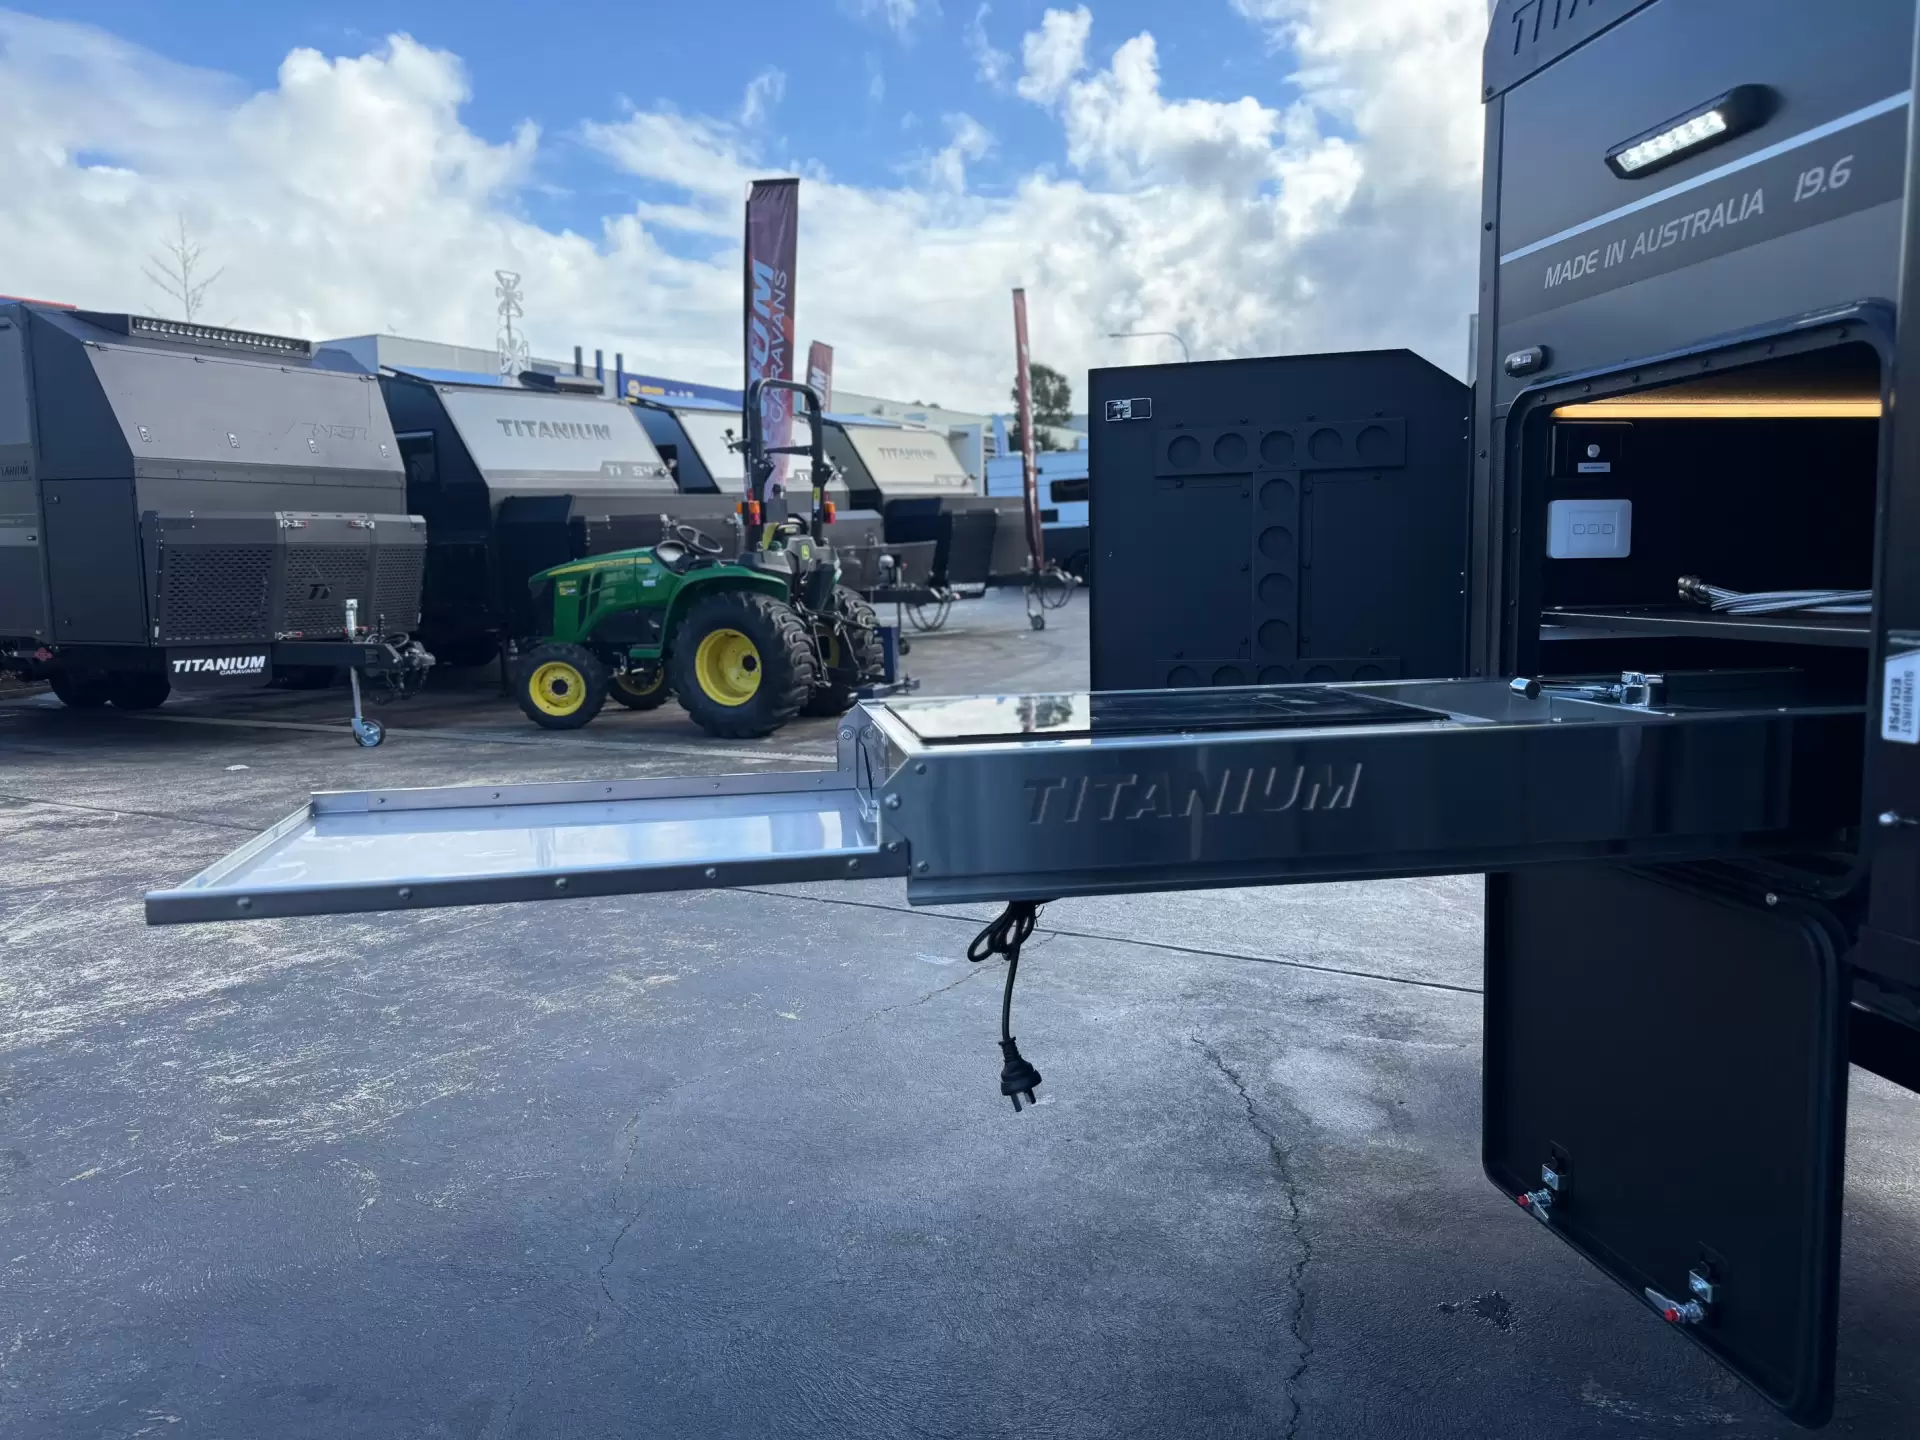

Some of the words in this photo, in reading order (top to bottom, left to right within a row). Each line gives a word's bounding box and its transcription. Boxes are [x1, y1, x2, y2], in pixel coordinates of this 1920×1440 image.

[1544, 249, 1600, 290] MADE
[1604, 239, 1626, 268] IN
[1631, 188, 1765, 259] AUSTRALIA
[1793, 155, 1855, 202] 19.6
[497, 419, 612, 440] TITANIUM
[172, 655, 266, 673] TITANIUM
[1888, 678, 1901, 732] ECLIPSE
[1024, 762, 1363, 825] TITANIUM
